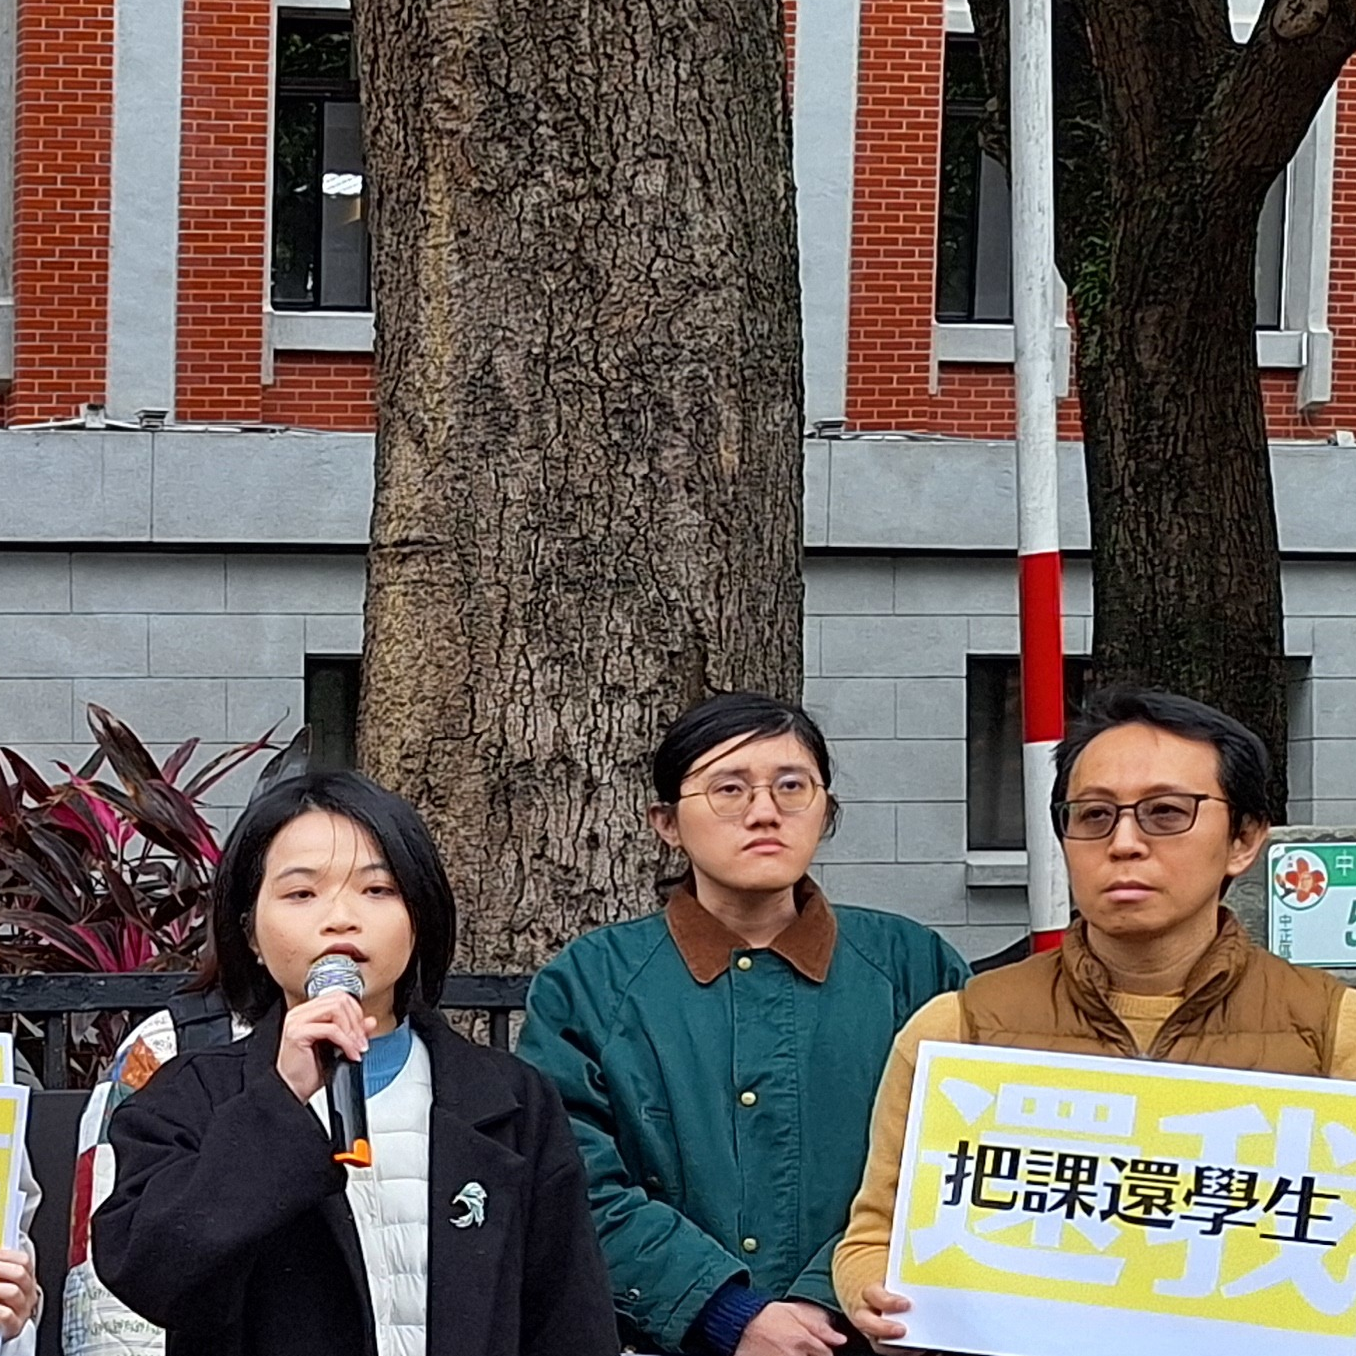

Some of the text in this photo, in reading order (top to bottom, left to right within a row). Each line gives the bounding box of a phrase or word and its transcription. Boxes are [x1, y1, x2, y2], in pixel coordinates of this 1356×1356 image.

[943, 1140, 1341, 1247] 把課還學生
